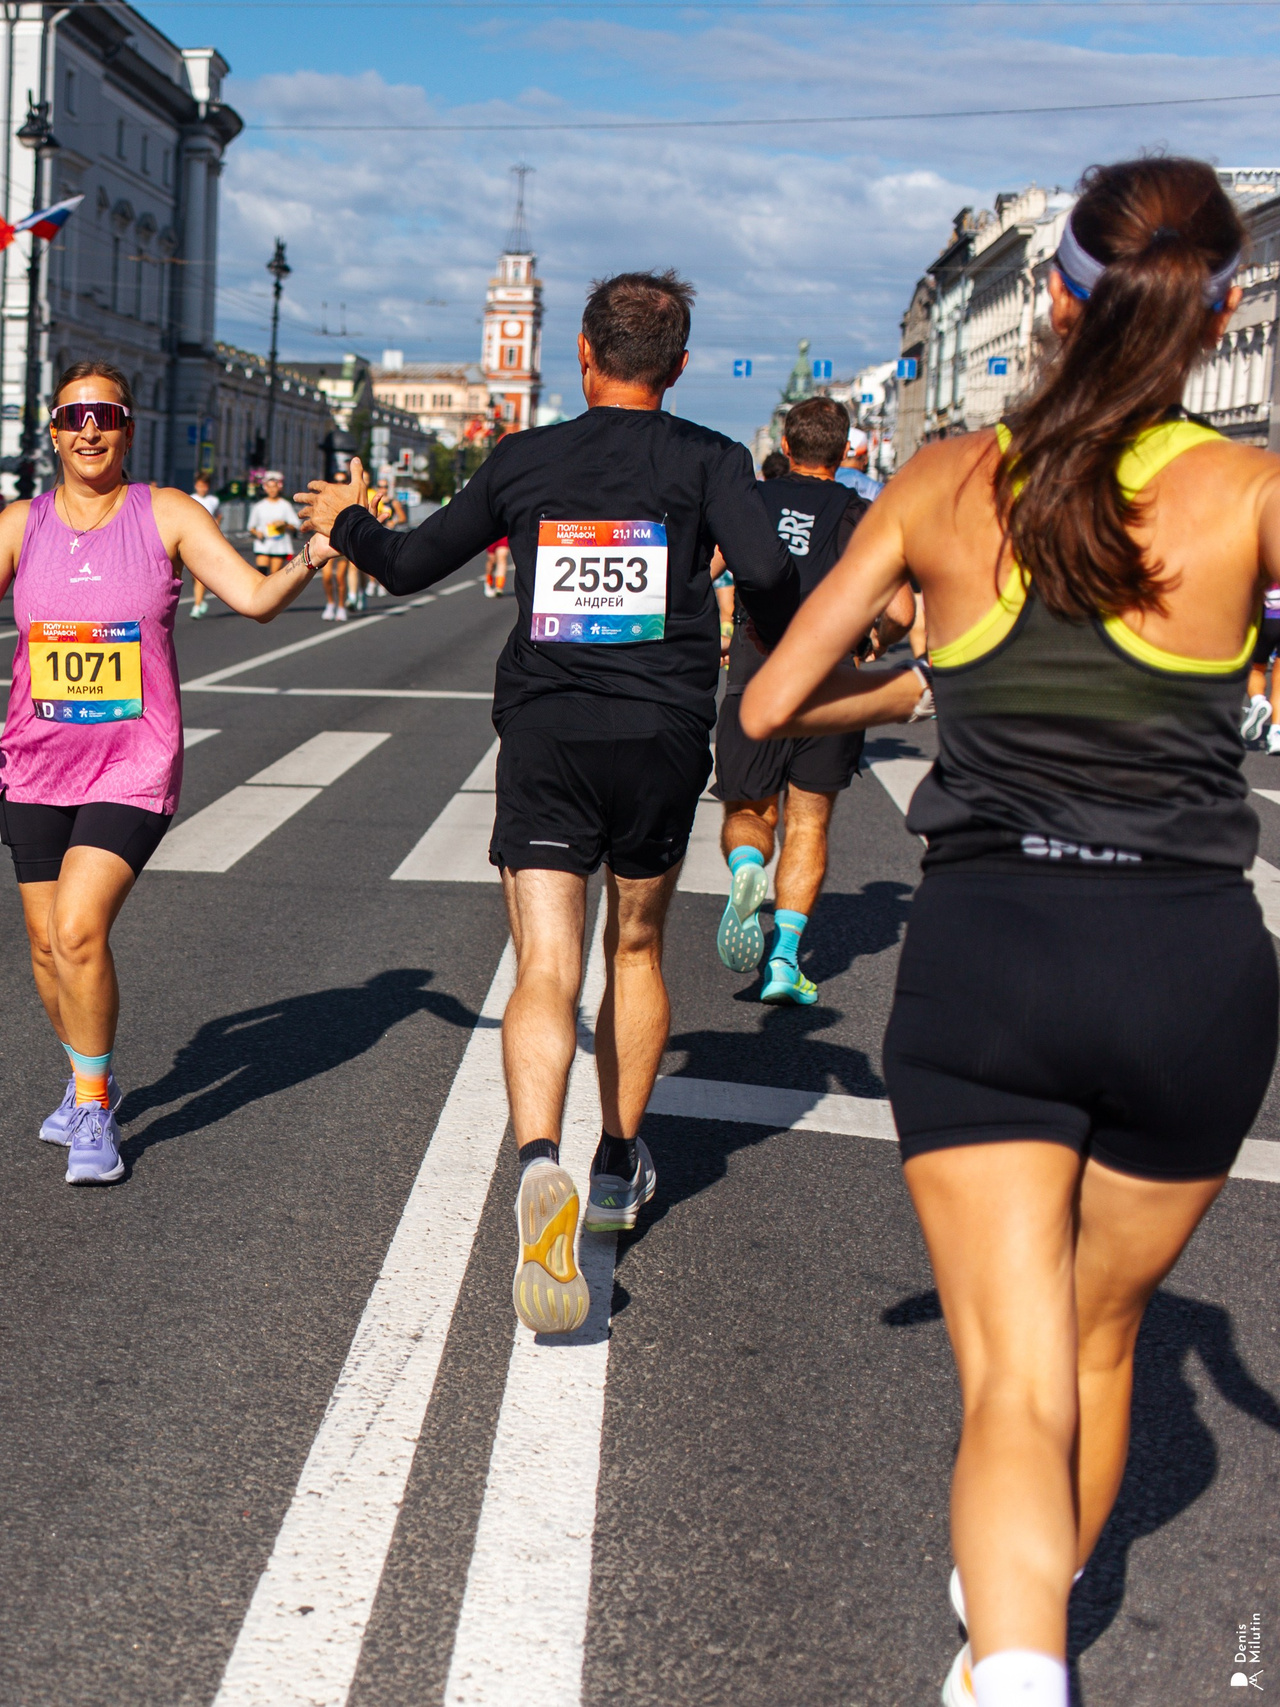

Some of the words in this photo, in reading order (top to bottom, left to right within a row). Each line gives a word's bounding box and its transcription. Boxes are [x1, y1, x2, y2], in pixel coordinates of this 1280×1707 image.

[556, 531, 596, 539] МАРАФОН
[613, 529, 630, 540] 21,1
[553, 556, 648, 593] 2553
[575, 595, 624, 608] АНДРЕЙ
[544, 616, 560, 636] D
[92, 629, 108, 638] 21,1
[46, 651, 121, 682] 1071
[67, 685, 103, 694] МАРИЯ
[42, 702, 55, 718] D
